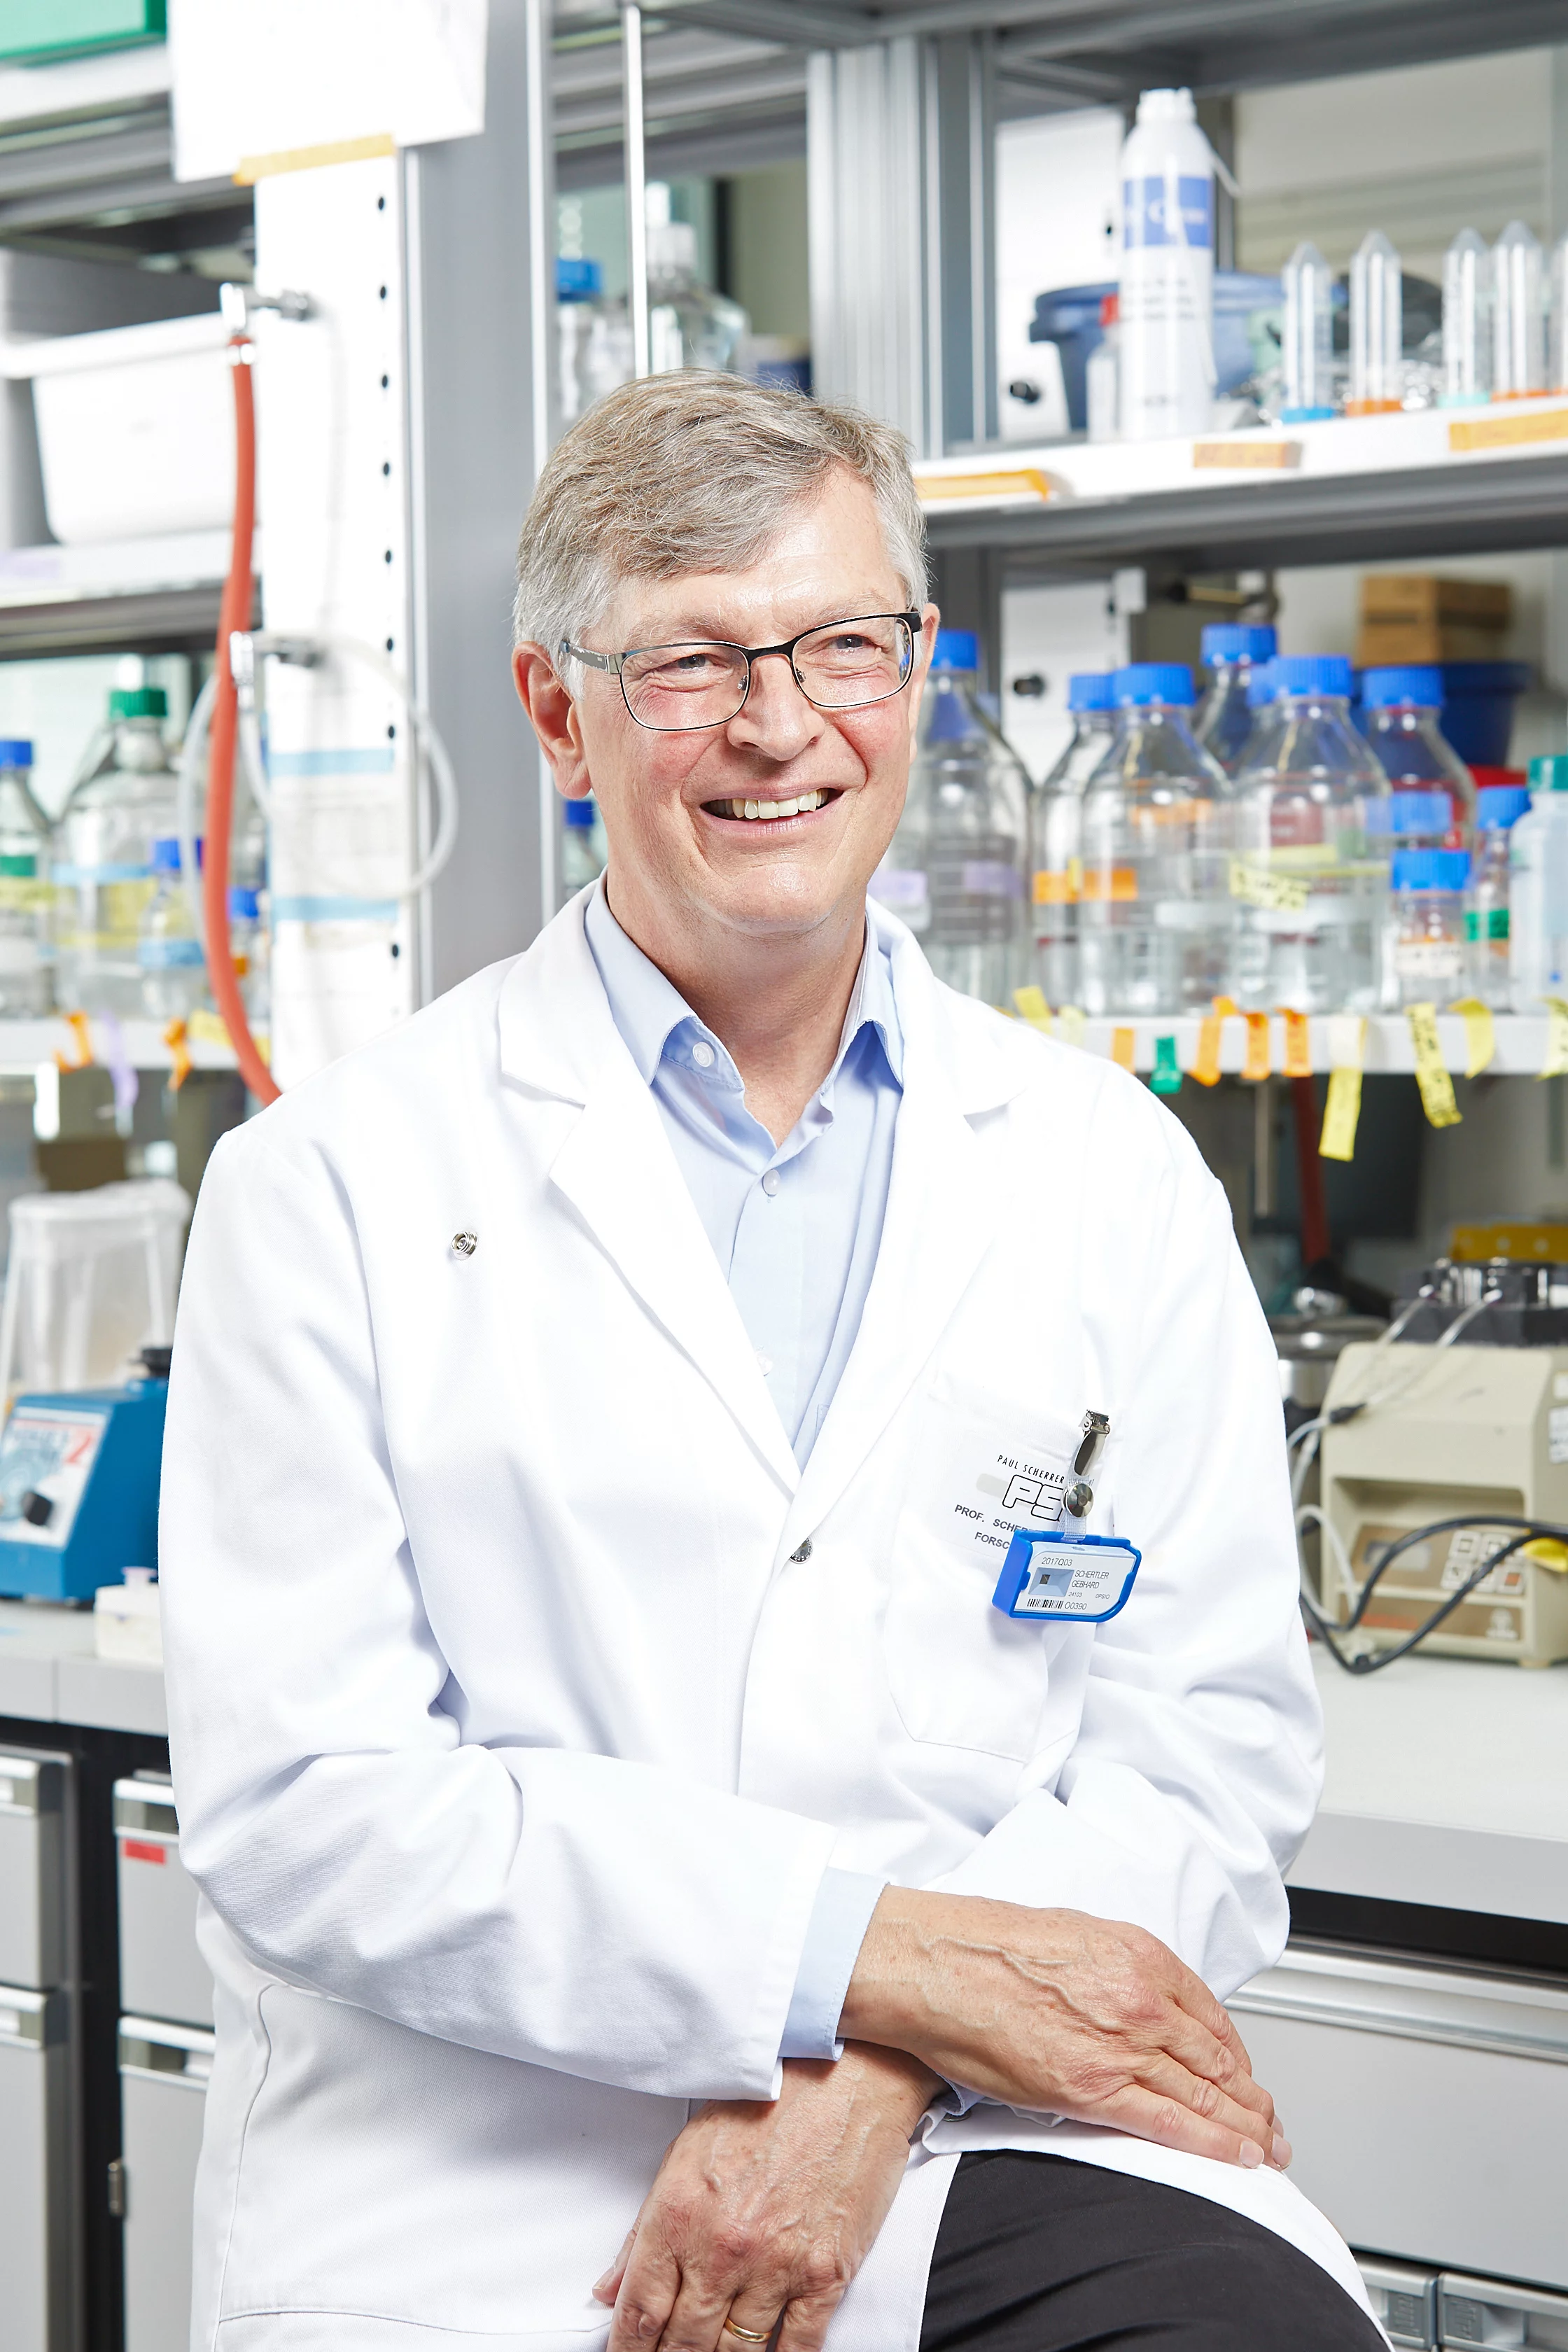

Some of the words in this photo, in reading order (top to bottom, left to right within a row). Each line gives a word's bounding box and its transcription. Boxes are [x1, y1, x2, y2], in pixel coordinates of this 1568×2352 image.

[997, 1455, 1018, 1469] PAUL
[1023, 1464, 1065, 1484] SCHERRER
[954, 1504, 984, 1522] PROF.
[1042, 1557, 1073, 1567] 2017Q03
[1074, 1569, 1110, 1580] SCHERTLER
[1071, 1580, 1100, 1589] GEBHARD
